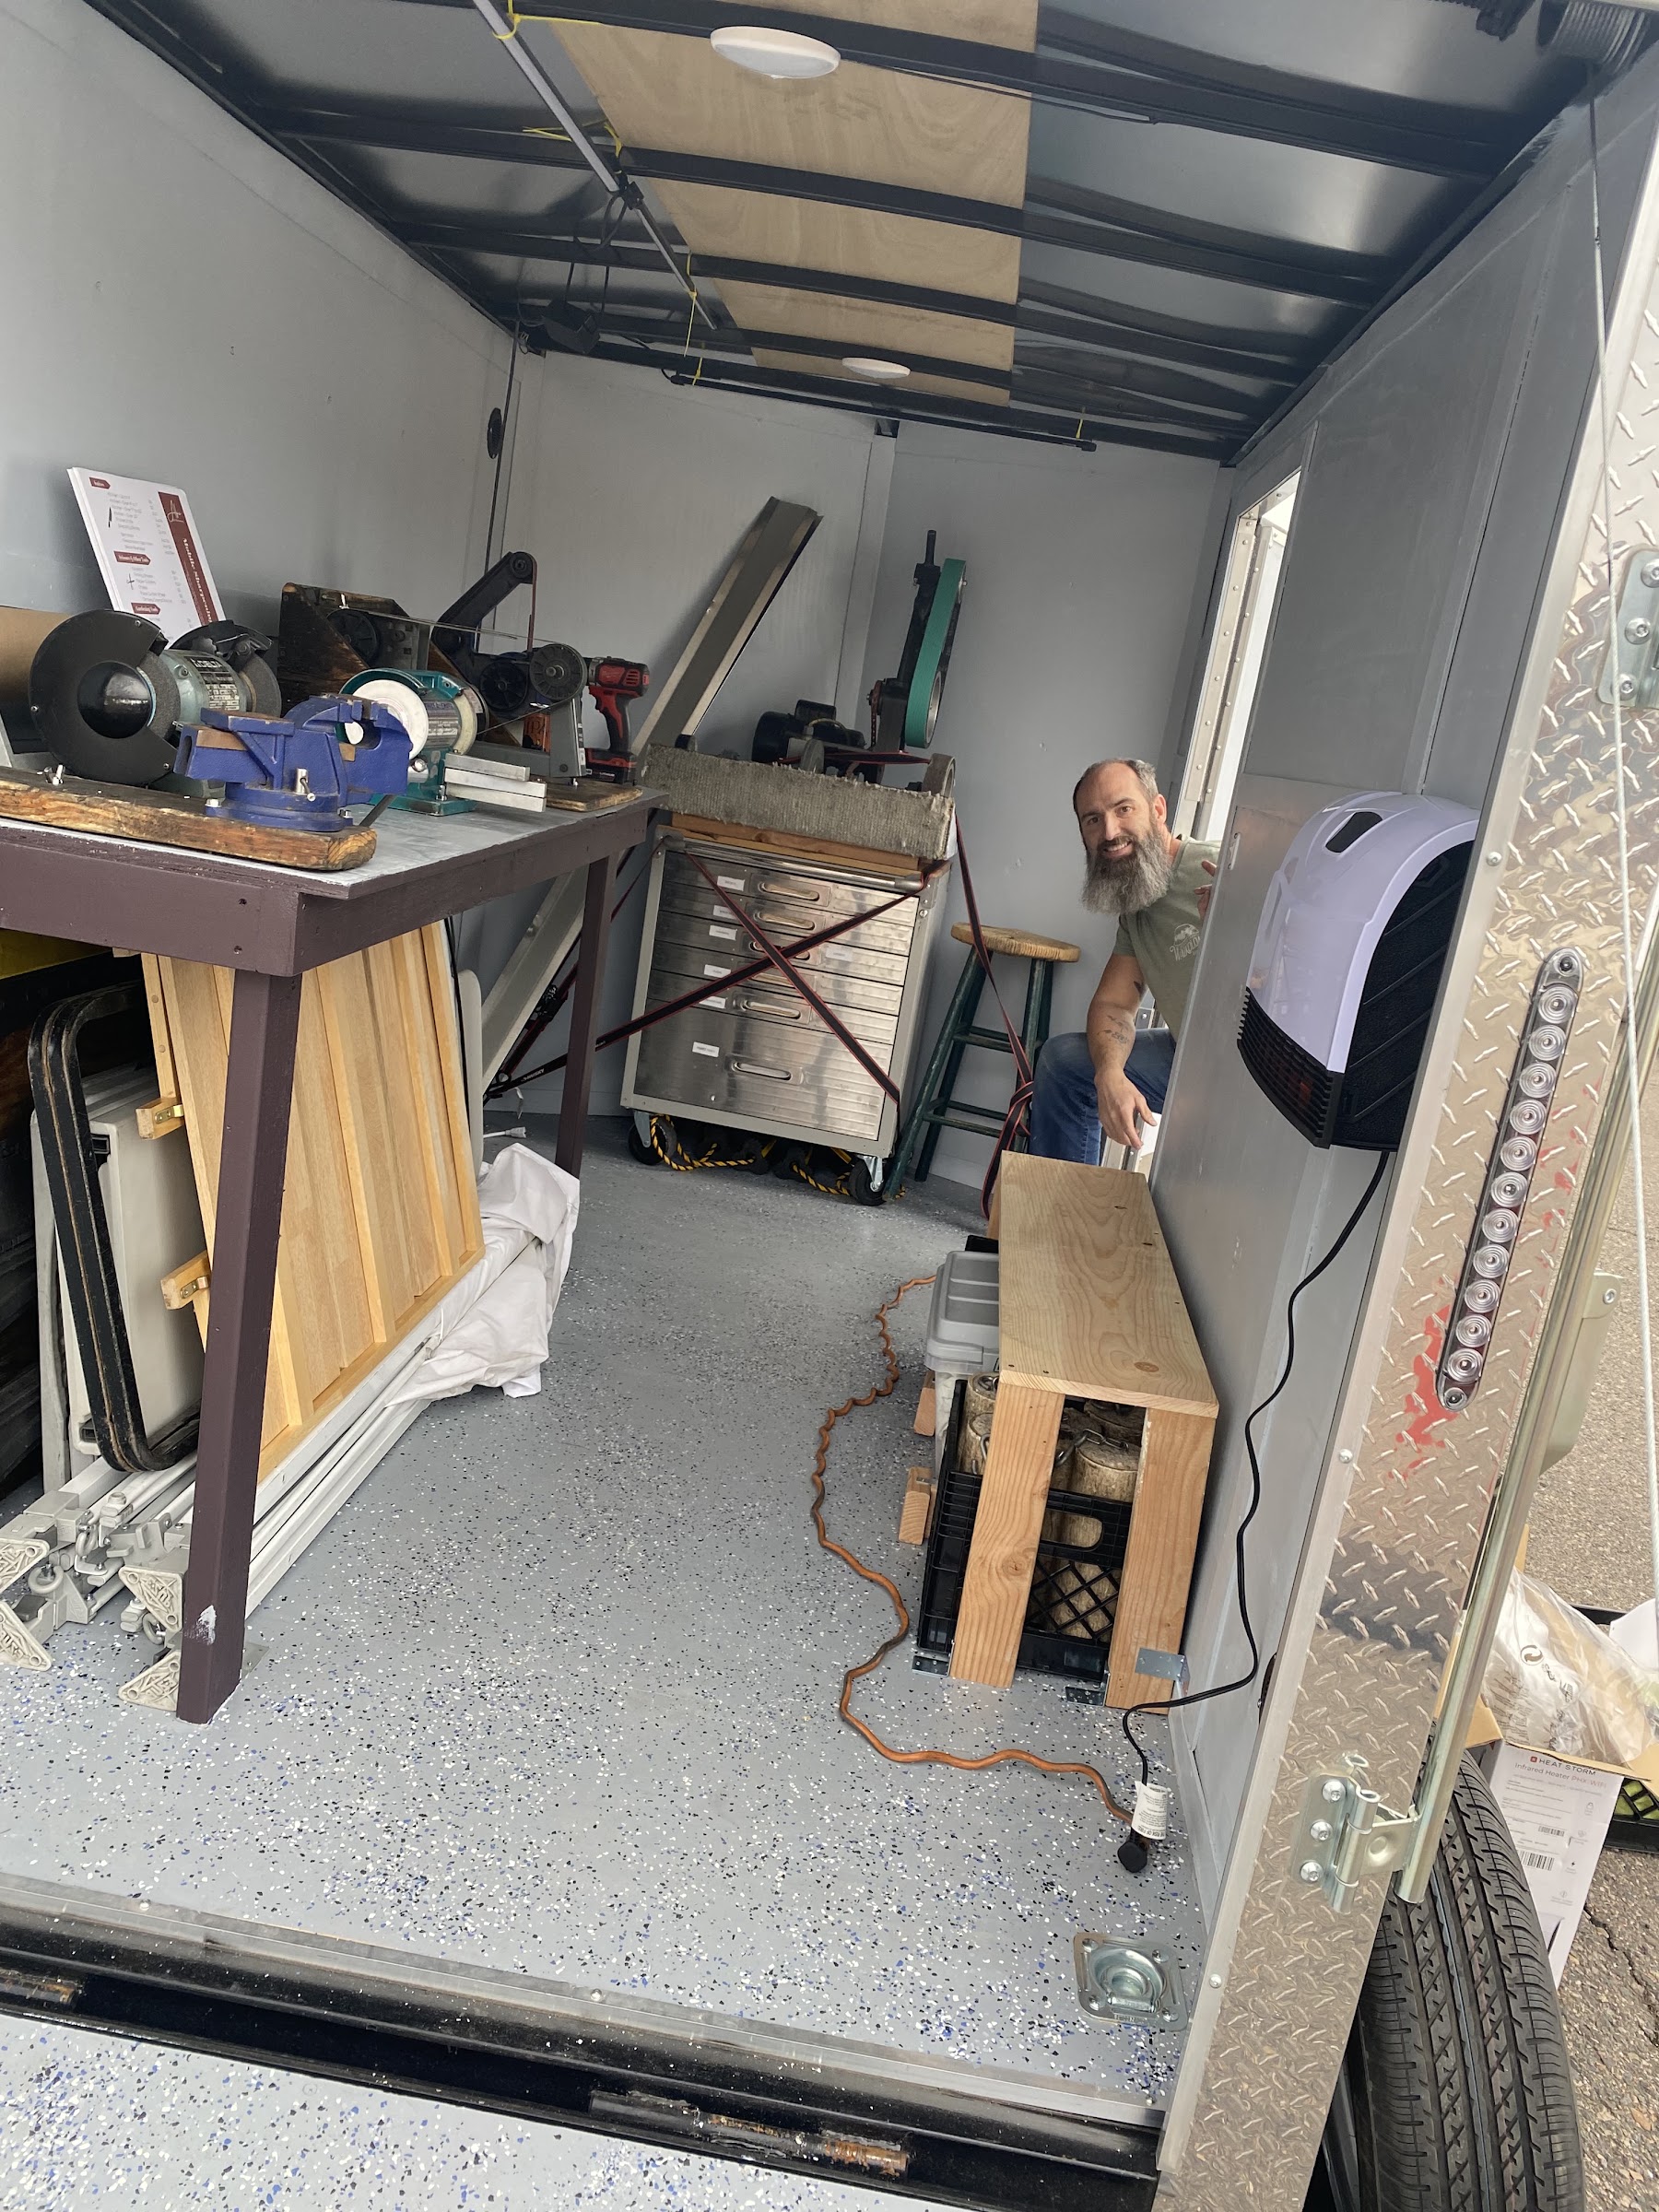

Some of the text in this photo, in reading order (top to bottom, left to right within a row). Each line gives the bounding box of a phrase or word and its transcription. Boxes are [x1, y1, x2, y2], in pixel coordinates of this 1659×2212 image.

[183, 537, 196, 571] Mobile
[1514, 1762, 1544, 1774] Infrared
[1545, 1771, 1570, 1780] Heater
[1538, 1758, 1595, 1776] HEAT STORM
